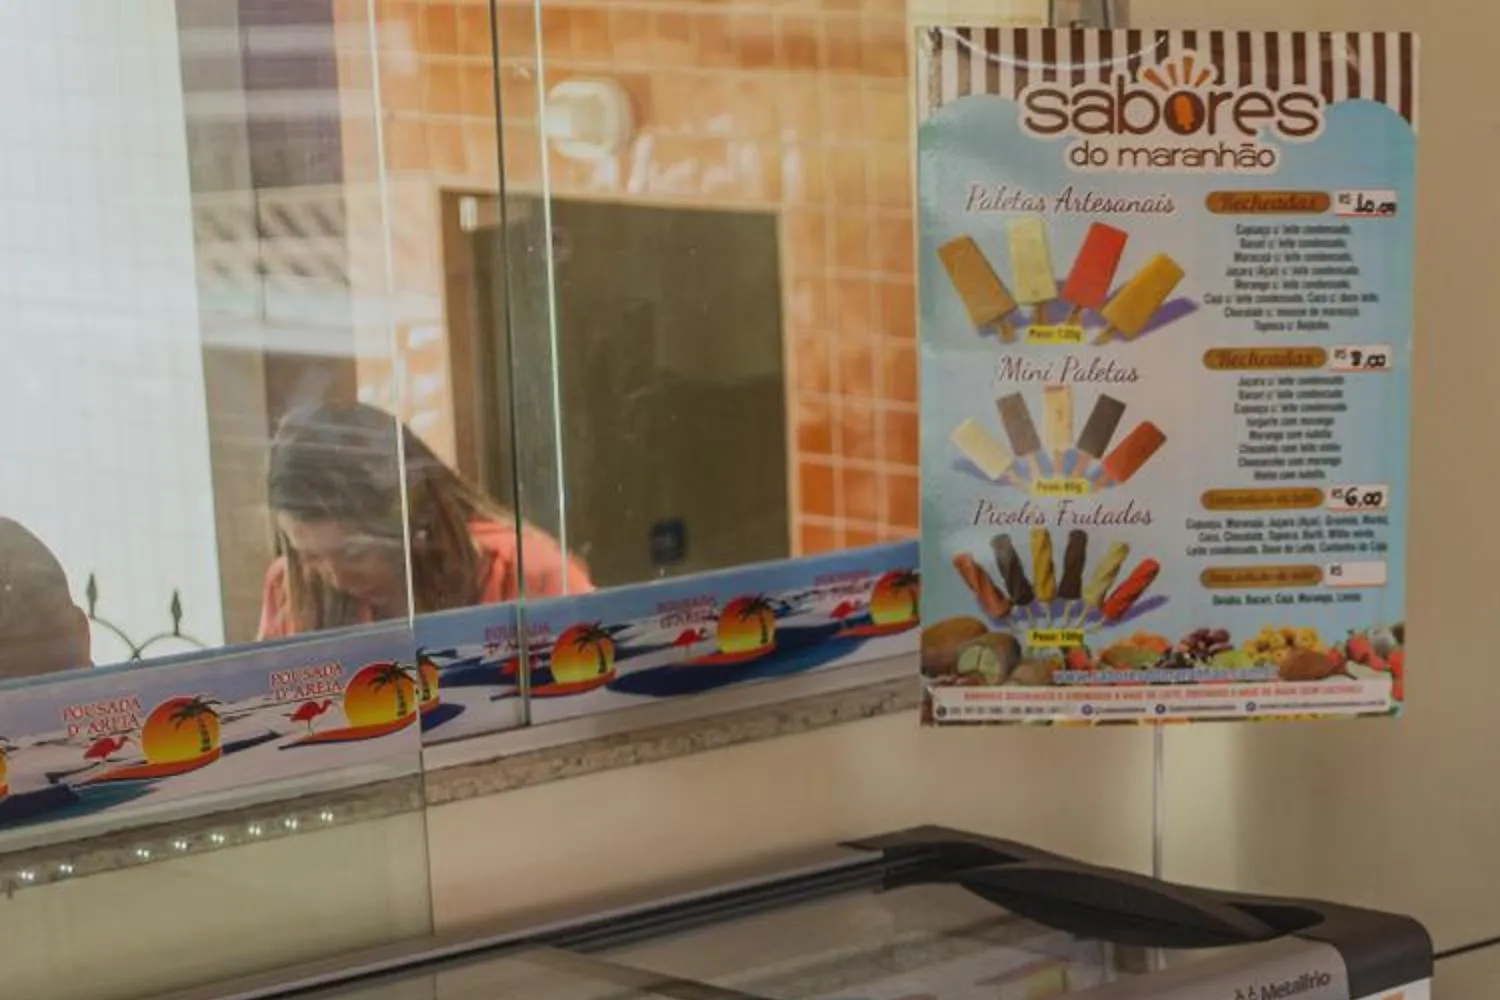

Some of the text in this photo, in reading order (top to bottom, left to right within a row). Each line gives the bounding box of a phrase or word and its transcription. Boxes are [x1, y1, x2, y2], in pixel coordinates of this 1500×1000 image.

[1024, 74, 1320, 137] sabores
[1071, 142, 1276, 168] do maranhão
[966, 185, 1175, 213] Paletas Artesanais
[999, 355, 1140, 383] Mini Paletas
[973, 499, 1154, 526] Picolés Frutados
[272, 663, 343, 688] POUSADA
[63, 696, 141, 721] POUSADA
